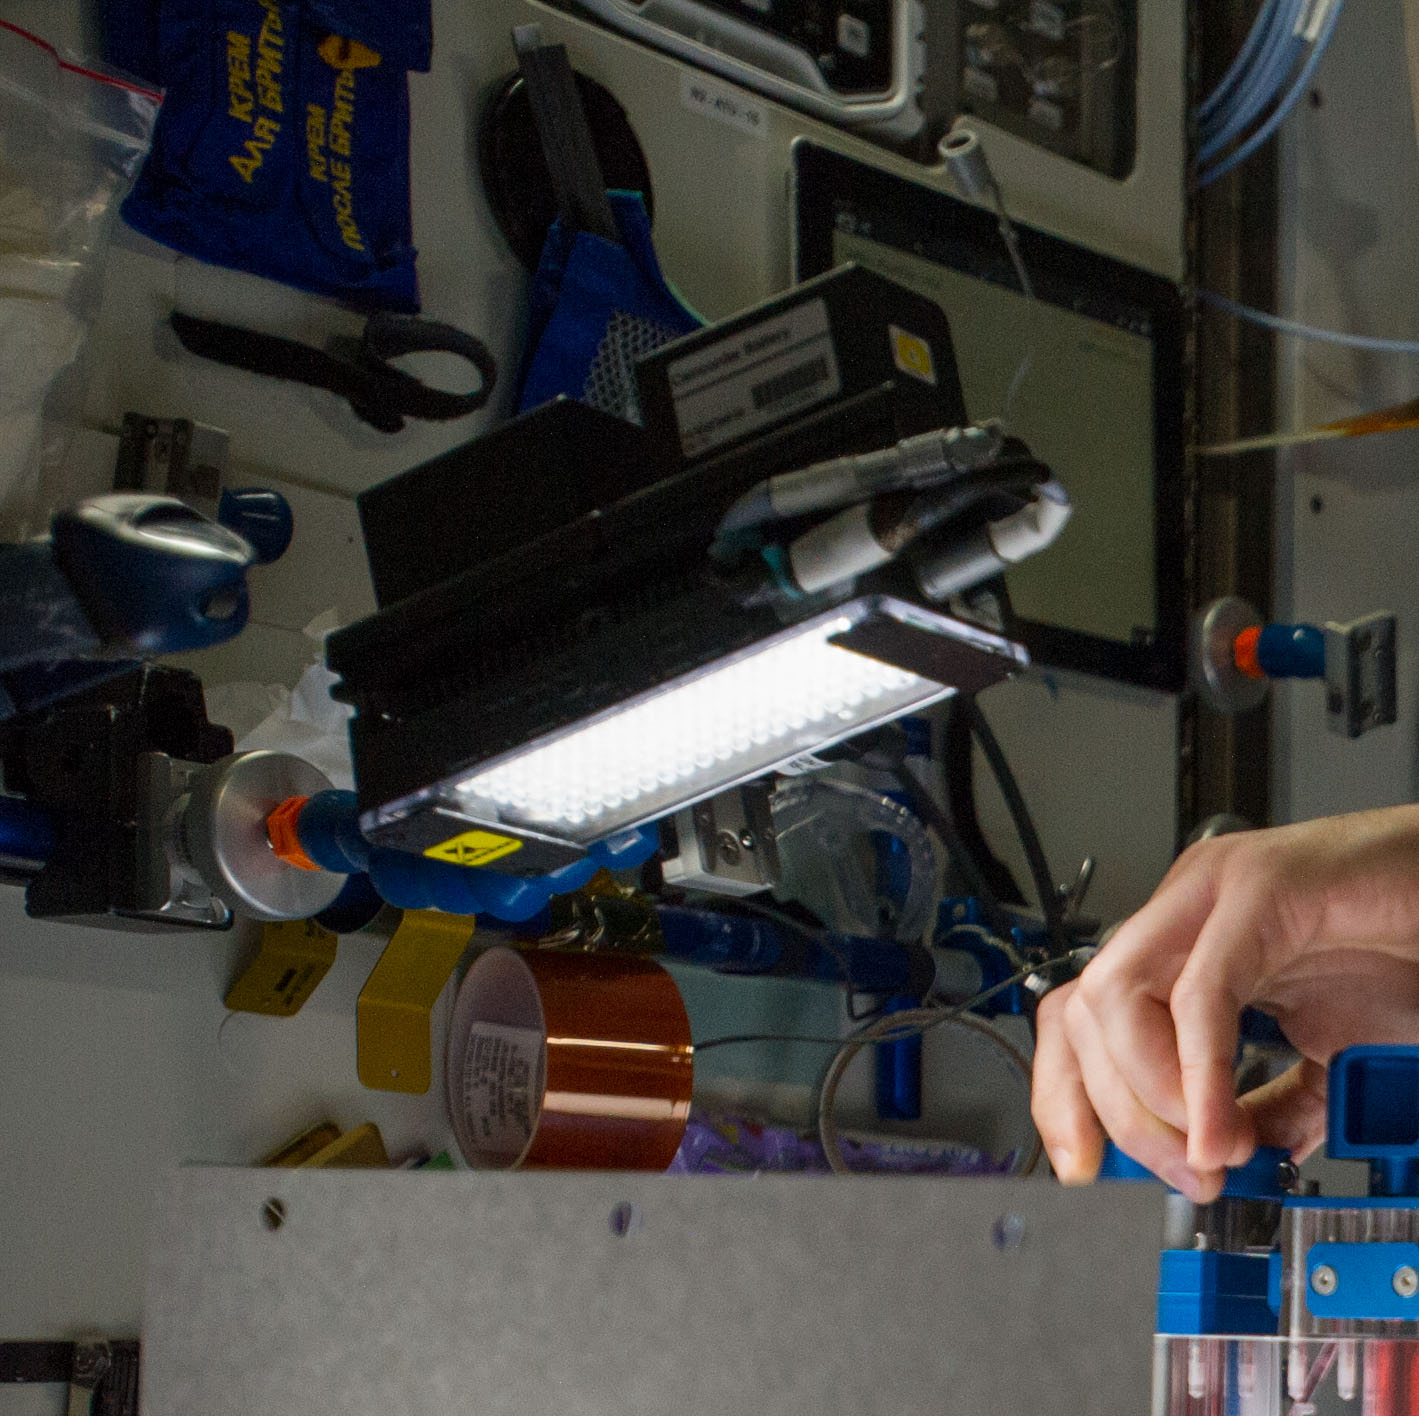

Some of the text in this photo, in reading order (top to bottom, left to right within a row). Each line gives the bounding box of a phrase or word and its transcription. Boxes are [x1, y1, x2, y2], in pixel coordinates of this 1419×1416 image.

[227, 30, 253, 123] КРЕМ
[228, 116, 280, 183] ДЛЯ
[306, 103, 327, 182] КРЕМ
[328, 68, 364, 250] ПОСЛЕ БРИТЬ
